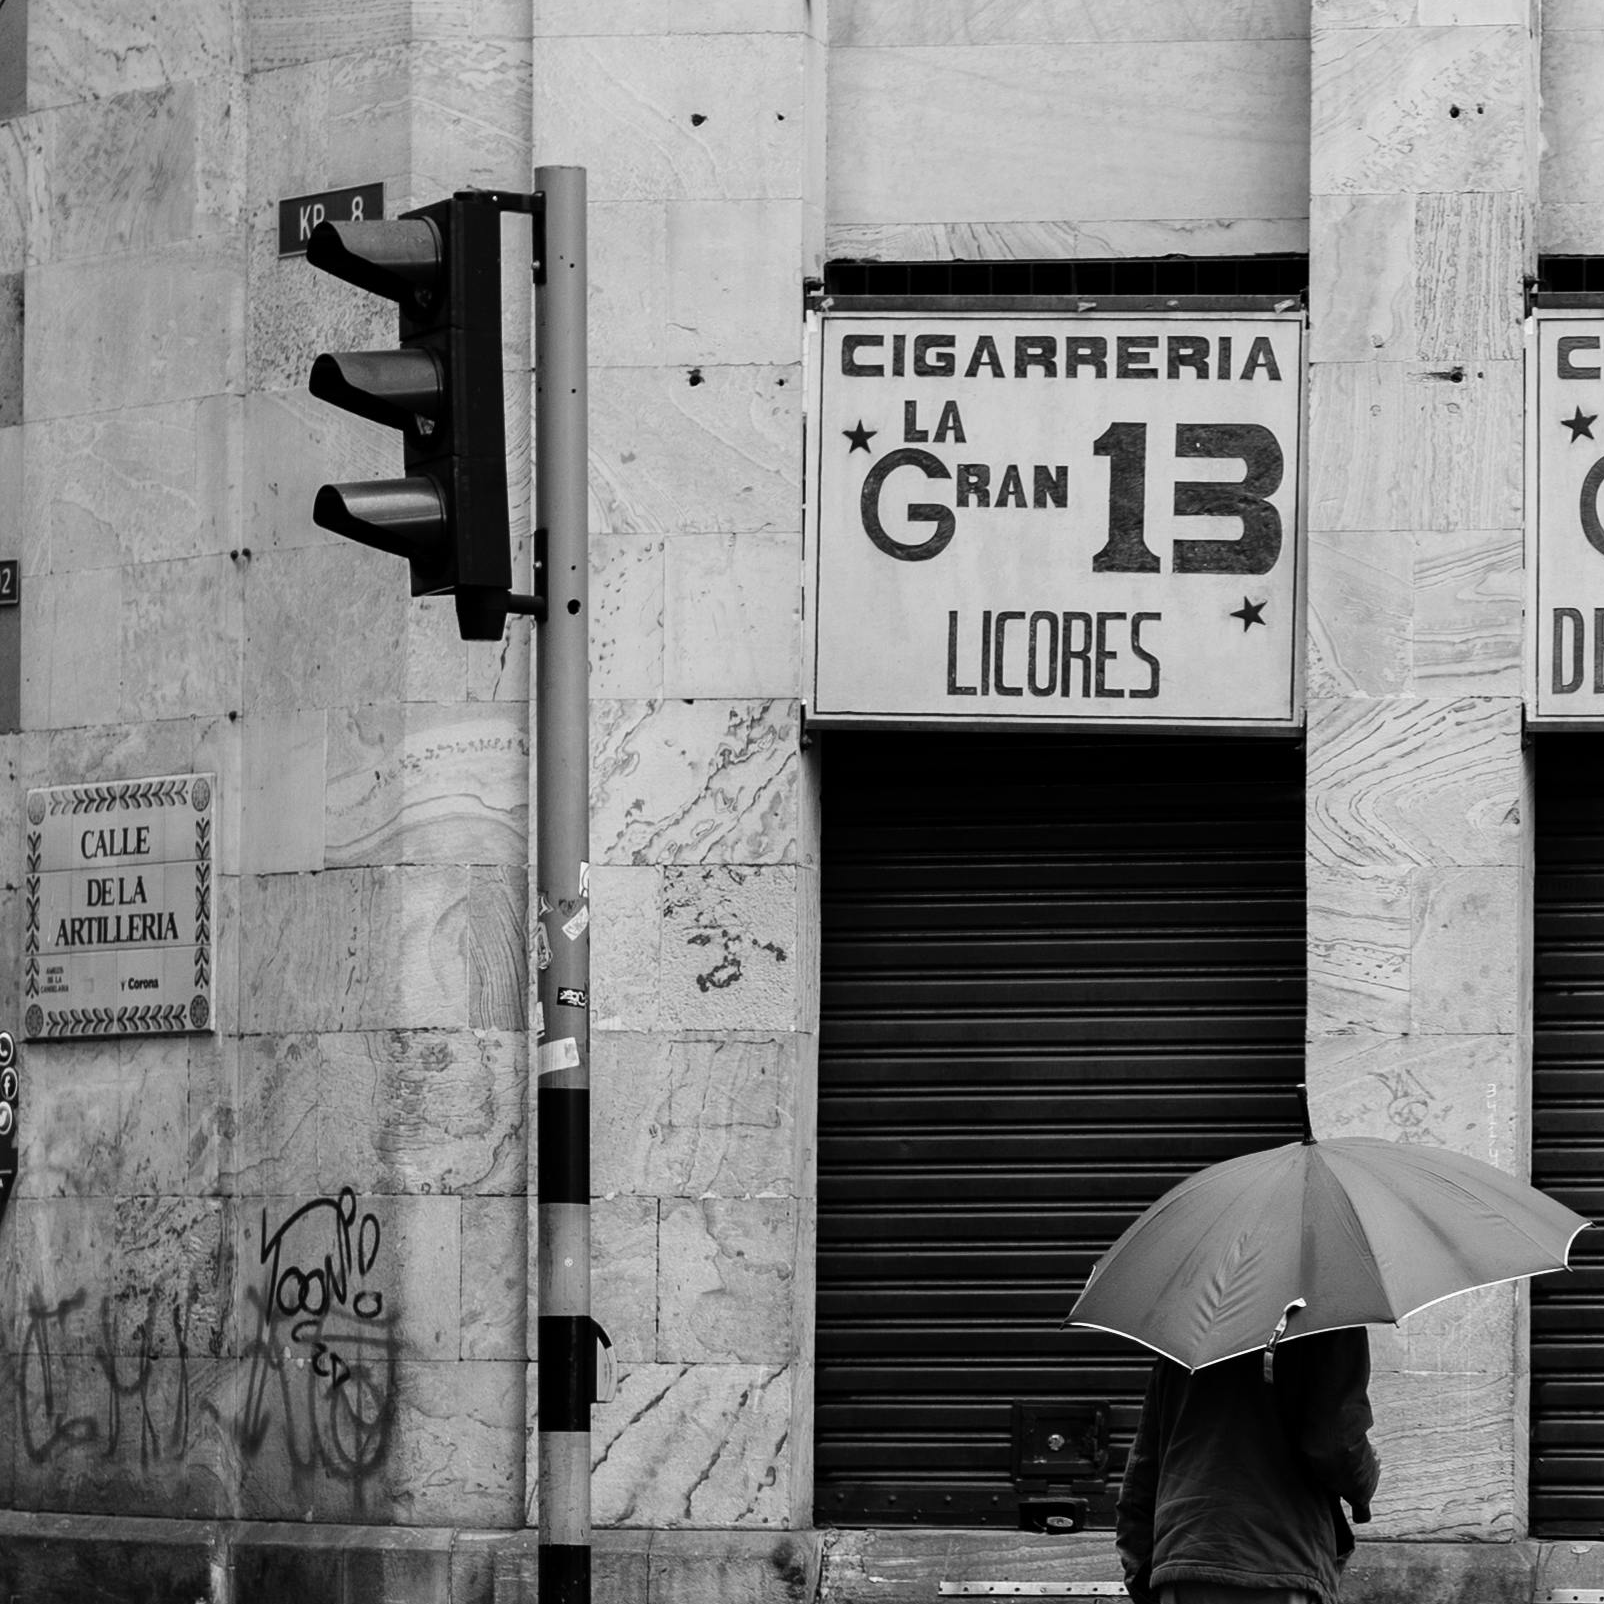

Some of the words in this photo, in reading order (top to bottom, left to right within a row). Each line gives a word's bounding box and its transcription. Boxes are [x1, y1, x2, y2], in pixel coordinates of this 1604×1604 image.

[842, 333, 1283, 382] CIGARRERIA
[904, 399, 967, 444] LA
[1092, 421, 1285, 576] 13
[946, 610, 1162, 699] LICORES
[80, 825, 151, 860] CALLE
[86, 877, 114, 907] DE
[119, 875, 148, 906] LA
[55, 911, 180, 947] ARTILLERIA
[127, 978, 159, 990] Corona
